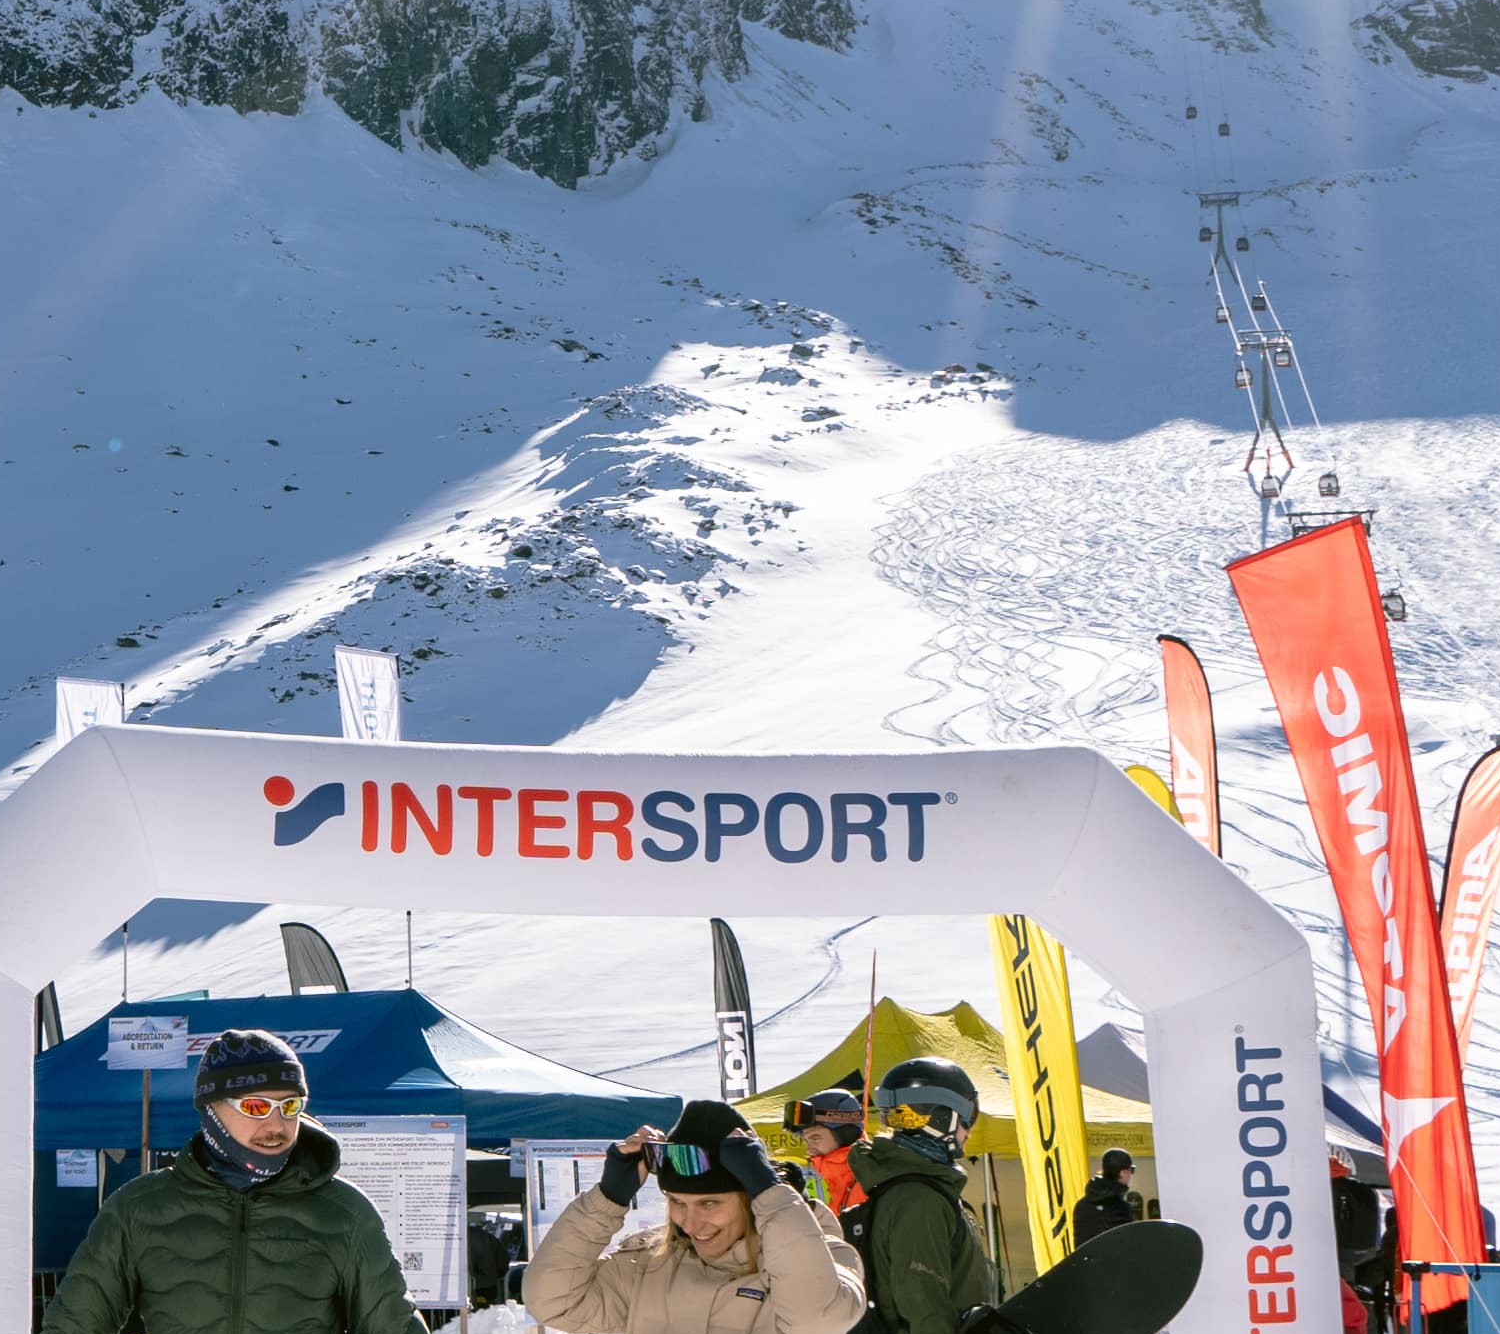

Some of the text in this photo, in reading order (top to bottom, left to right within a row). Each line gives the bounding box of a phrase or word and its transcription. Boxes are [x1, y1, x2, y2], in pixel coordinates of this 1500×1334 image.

[361, 779, 940, 863] INTERSPORT
[122, 1032, 173, 1042] ACCREDITATION
[138, 1041, 164, 1051] RETURN
